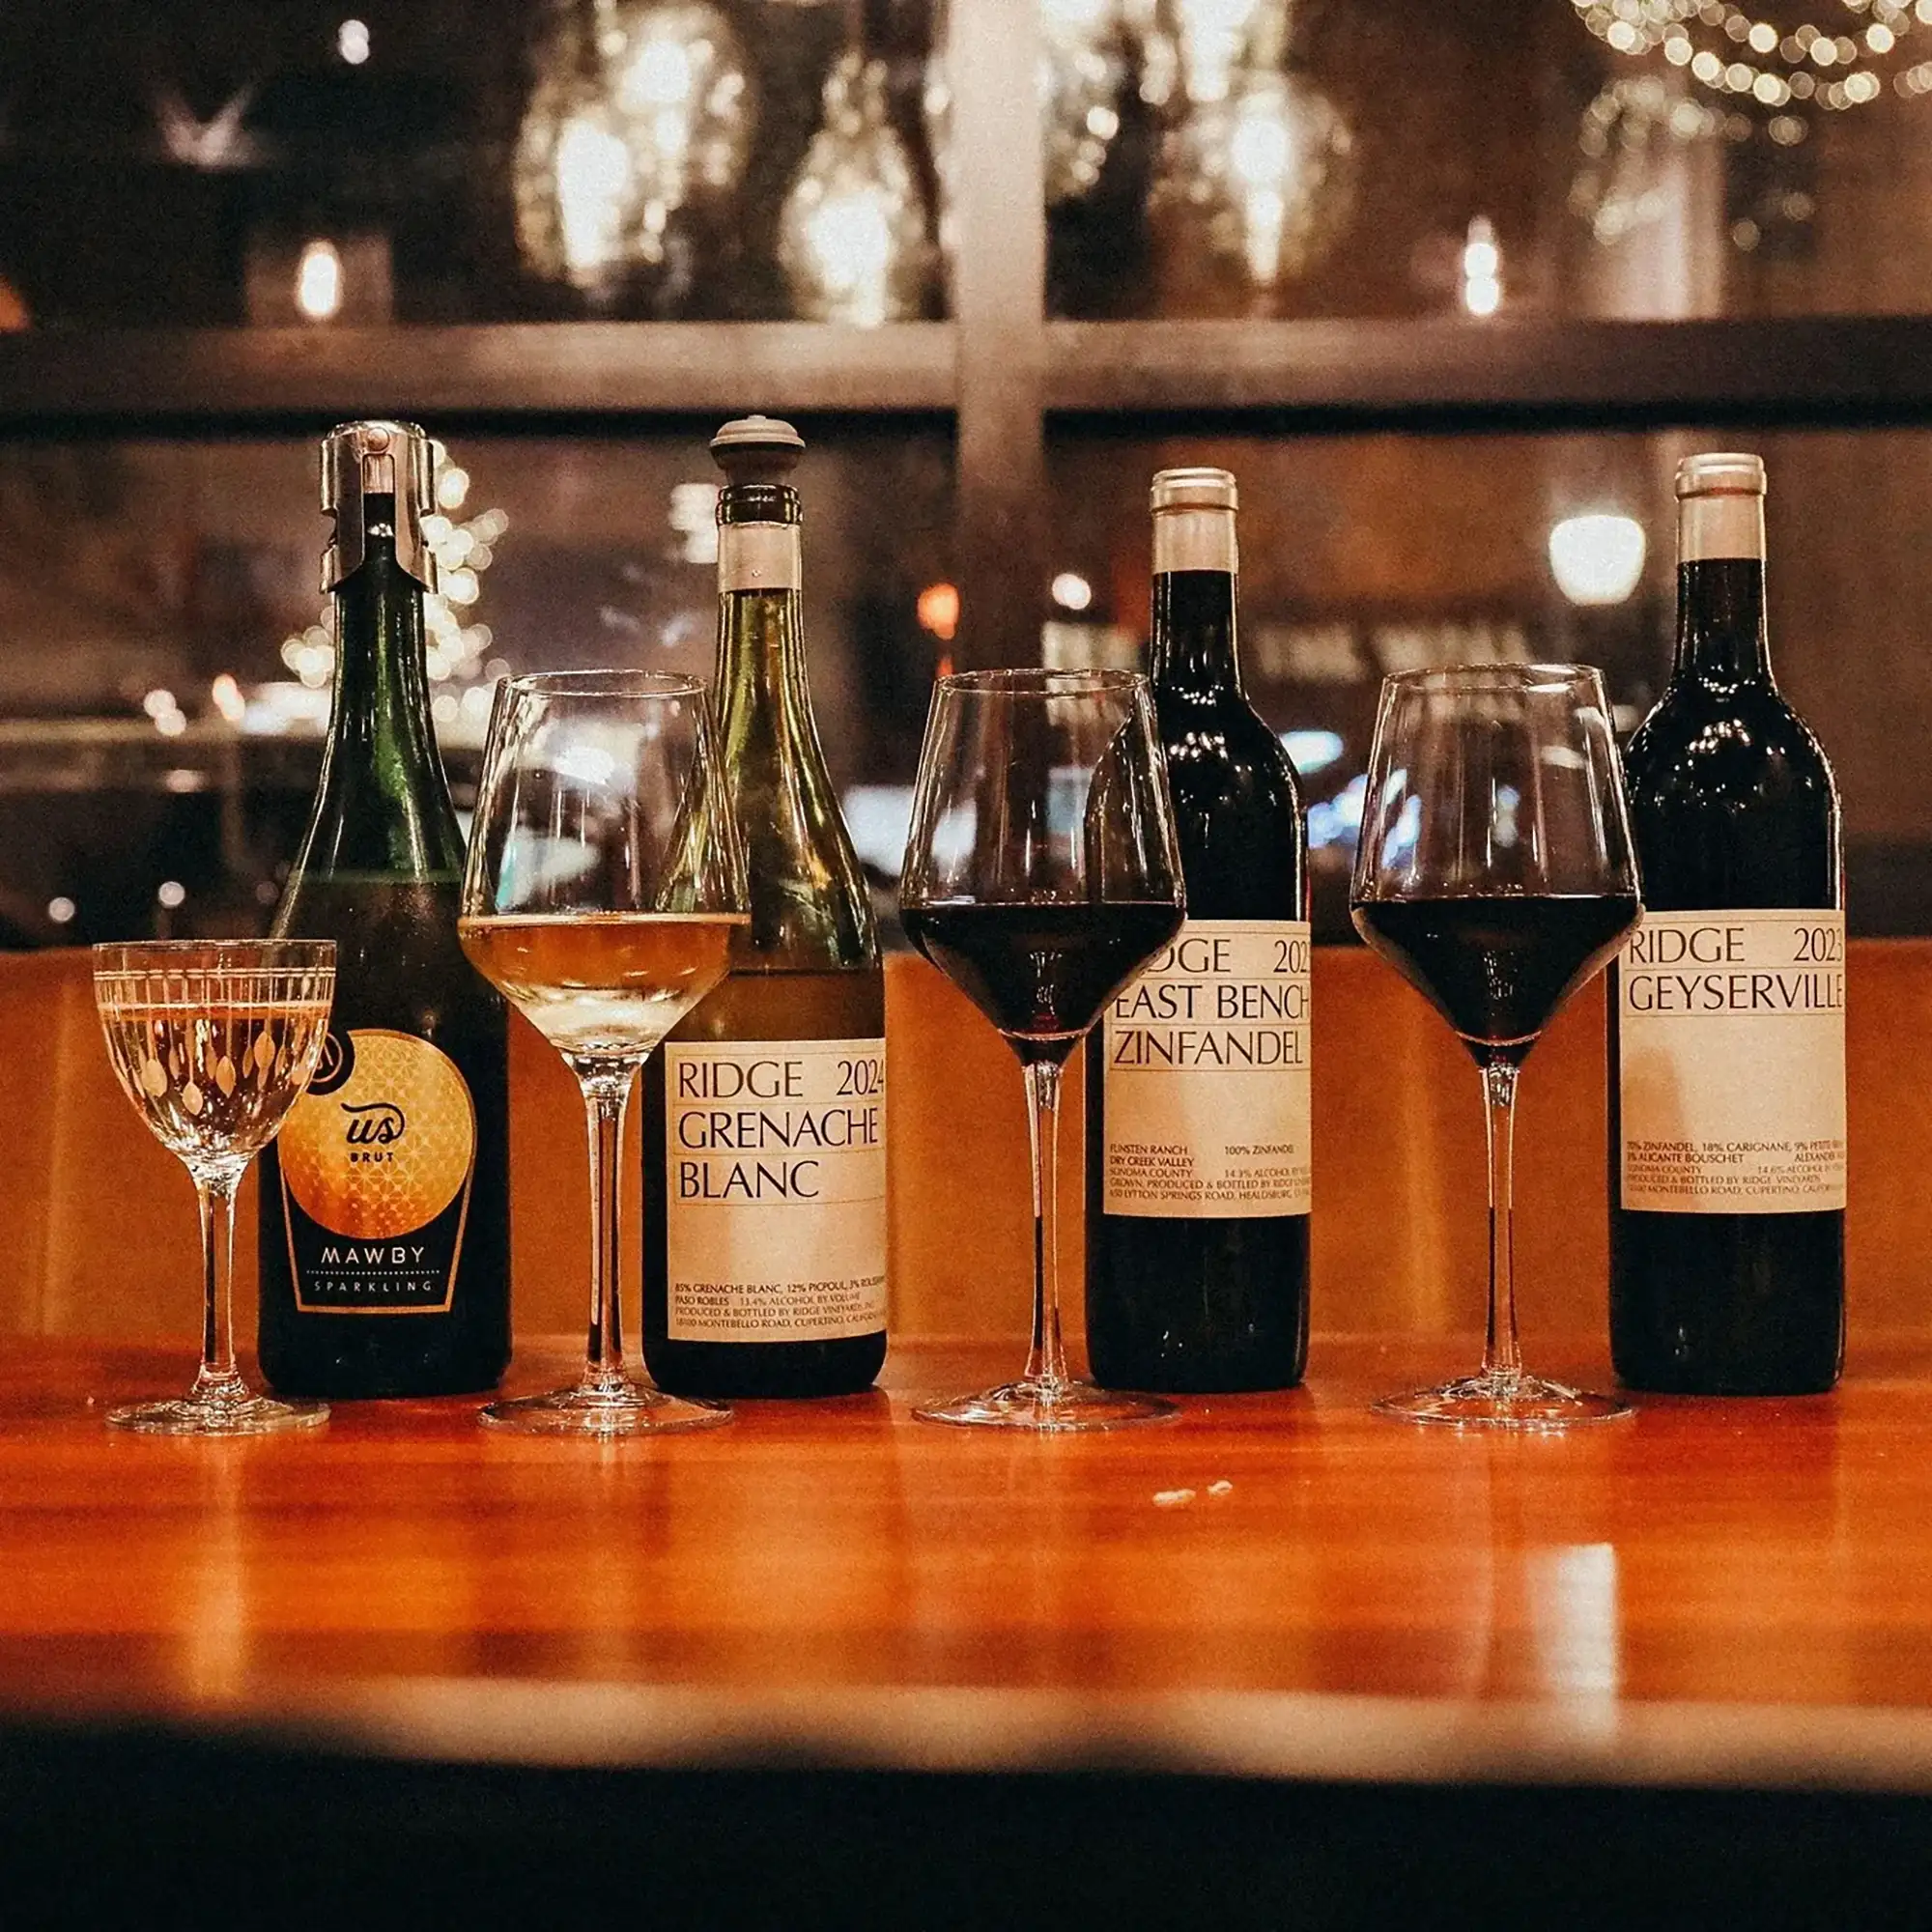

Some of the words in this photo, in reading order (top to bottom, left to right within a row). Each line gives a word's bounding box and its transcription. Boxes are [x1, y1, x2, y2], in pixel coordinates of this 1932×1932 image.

[1630, 927, 1746, 964] RIDGE
[1792, 927, 1843, 962] 2023
[1147, 938, 1232, 973] DGE
[1272, 939, 1310, 974] 202
[1629, 974, 1843, 1010] GEYSERVILLE
[1116, 984, 1203, 1019] EAST
[1217, 984, 1309, 1019] BENCH
[1114, 1031, 1303, 1065] ZINFANDEL
[679, 1061, 804, 1097] RIDGE
[836, 1059, 884, 1096] 2024
[341, 1102, 406, 1144] us
[678, 1108, 878, 1148] GRENACHE
[1150, 1145, 1188, 1156] RANCH
[1224, 1146, 1251, 1156] 100%
[1701, 1143, 1723, 1152] 18%
[350, 1151, 394, 1163] BRUT
[1109, 1155, 1126, 1165] DRY
[1127, 1156, 1156, 1167] CREEK
[1158, 1156, 1195, 1168] VALLEY
[1639, 1151, 1682, 1162] ALICANTE
[1684, 1152, 1745, 1164] BOUSCHET
[1149, 1168, 1194, 1179] COUNTY
[1662, 1165, 1702, 1175] COUNTY
[680, 1160, 819, 1199] BLANC
[1147, 1179, 1204, 1190] PRODUCED
[1216, 1179, 1259, 1190] BOTTLED
[1680, 1175, 1725, 1185] BOTTLED
[1726, 1175, 1739, 1185] BY
[1742, 1175, 1772, 1185] RIDGE
[1160, 1190, 1203, 1201] SPRINGS
[320, 1246, 425, 1264] MAWBY
[314, 1280, 433, 1292] SPARKLING
[693, 1283, 744, 1294] GRENACHE
[786, 1282, 807, 1293] 12%
[696, 1295, 730, 1306] ROBLES
[769, 1294, 815, 1306] ALCOHOL
[675, 1306, 722, 1318] PRODUCED
[724, 1307, 730, 1317] &
[733, 1307, 777, 1318] BOTTLED
[778, 1307, 790, 1317] BY
[792, 1305, 820, 1317] RIDGE
[698, 1317, 760, 1328] MONTEBELLO
